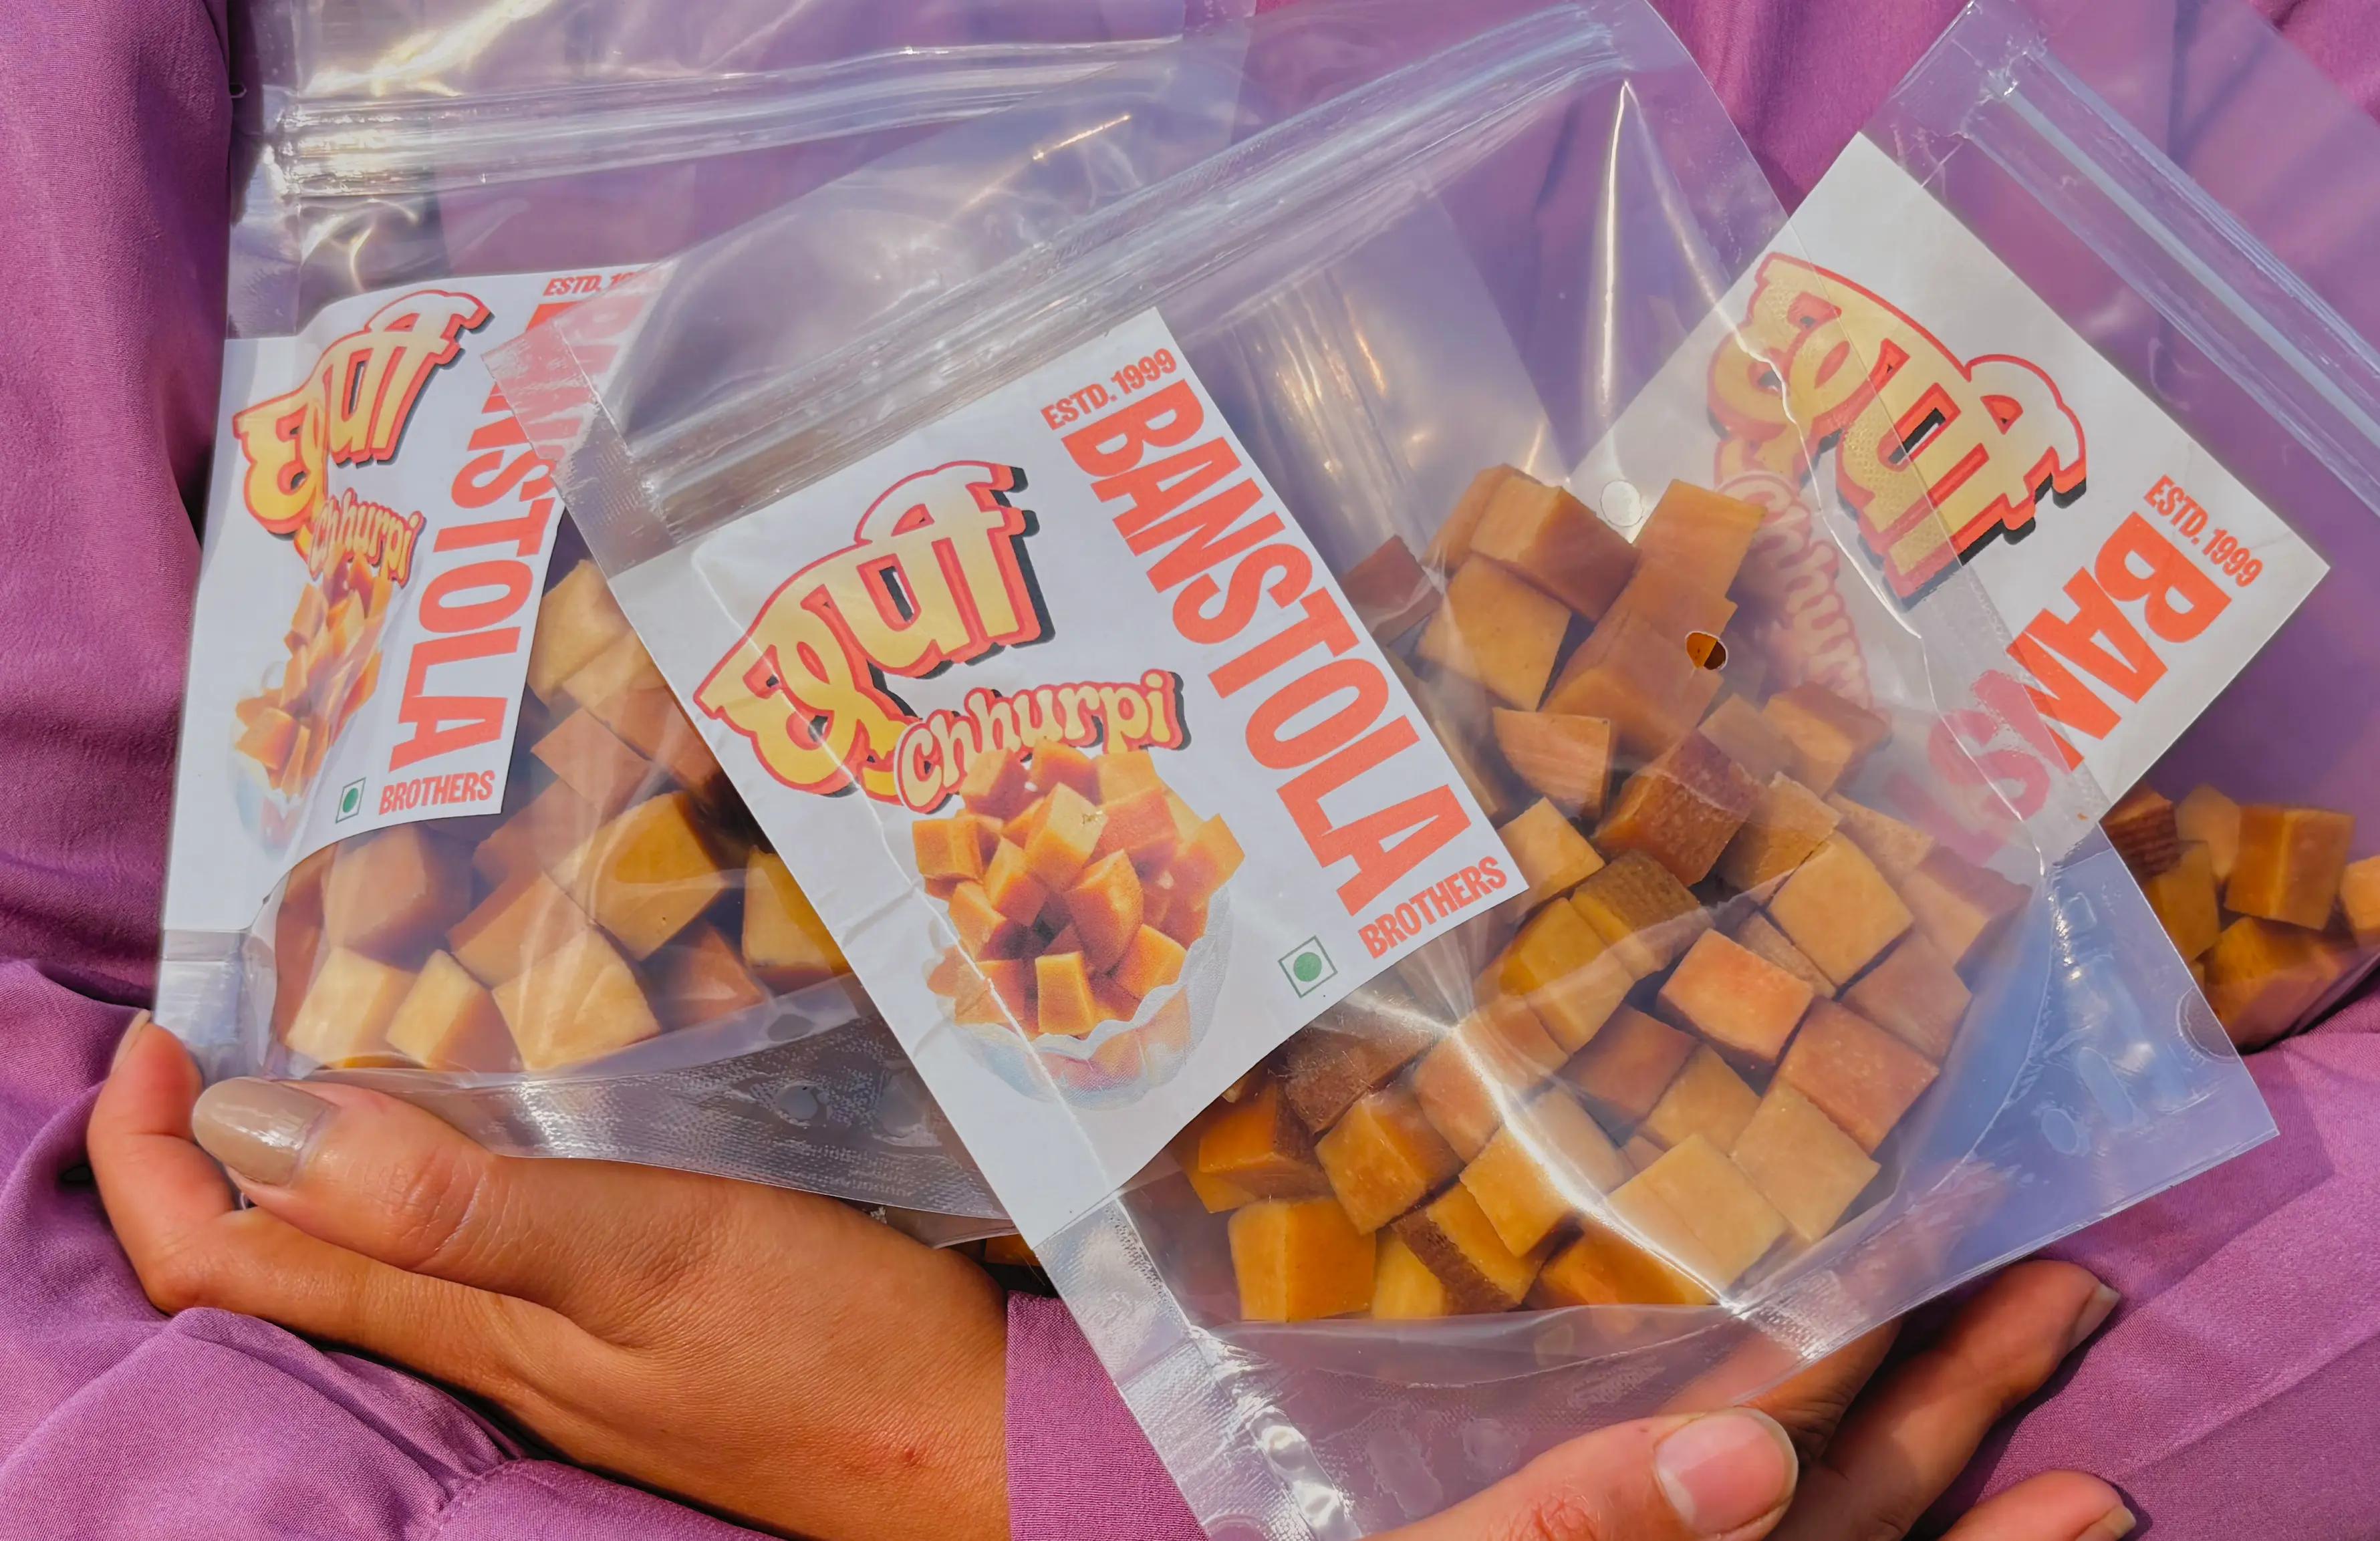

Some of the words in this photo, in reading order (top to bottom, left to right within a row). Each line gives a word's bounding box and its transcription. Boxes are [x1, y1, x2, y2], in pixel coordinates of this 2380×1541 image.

[543, 274, 603, 296] ESTD.
[1040, 384, 1117, 430] ESTD.
[1110, 347, 1178, 393] 1999
[2143, 474, 2203, 547] ESTD.
[2198, 527, 2263, 588] 1999
[1060, 378, 1471, 916] BANSTOLA
[378, 770, 495, 816] BROTHERS
[1357, 856, 1507, 959] BROTHERS
